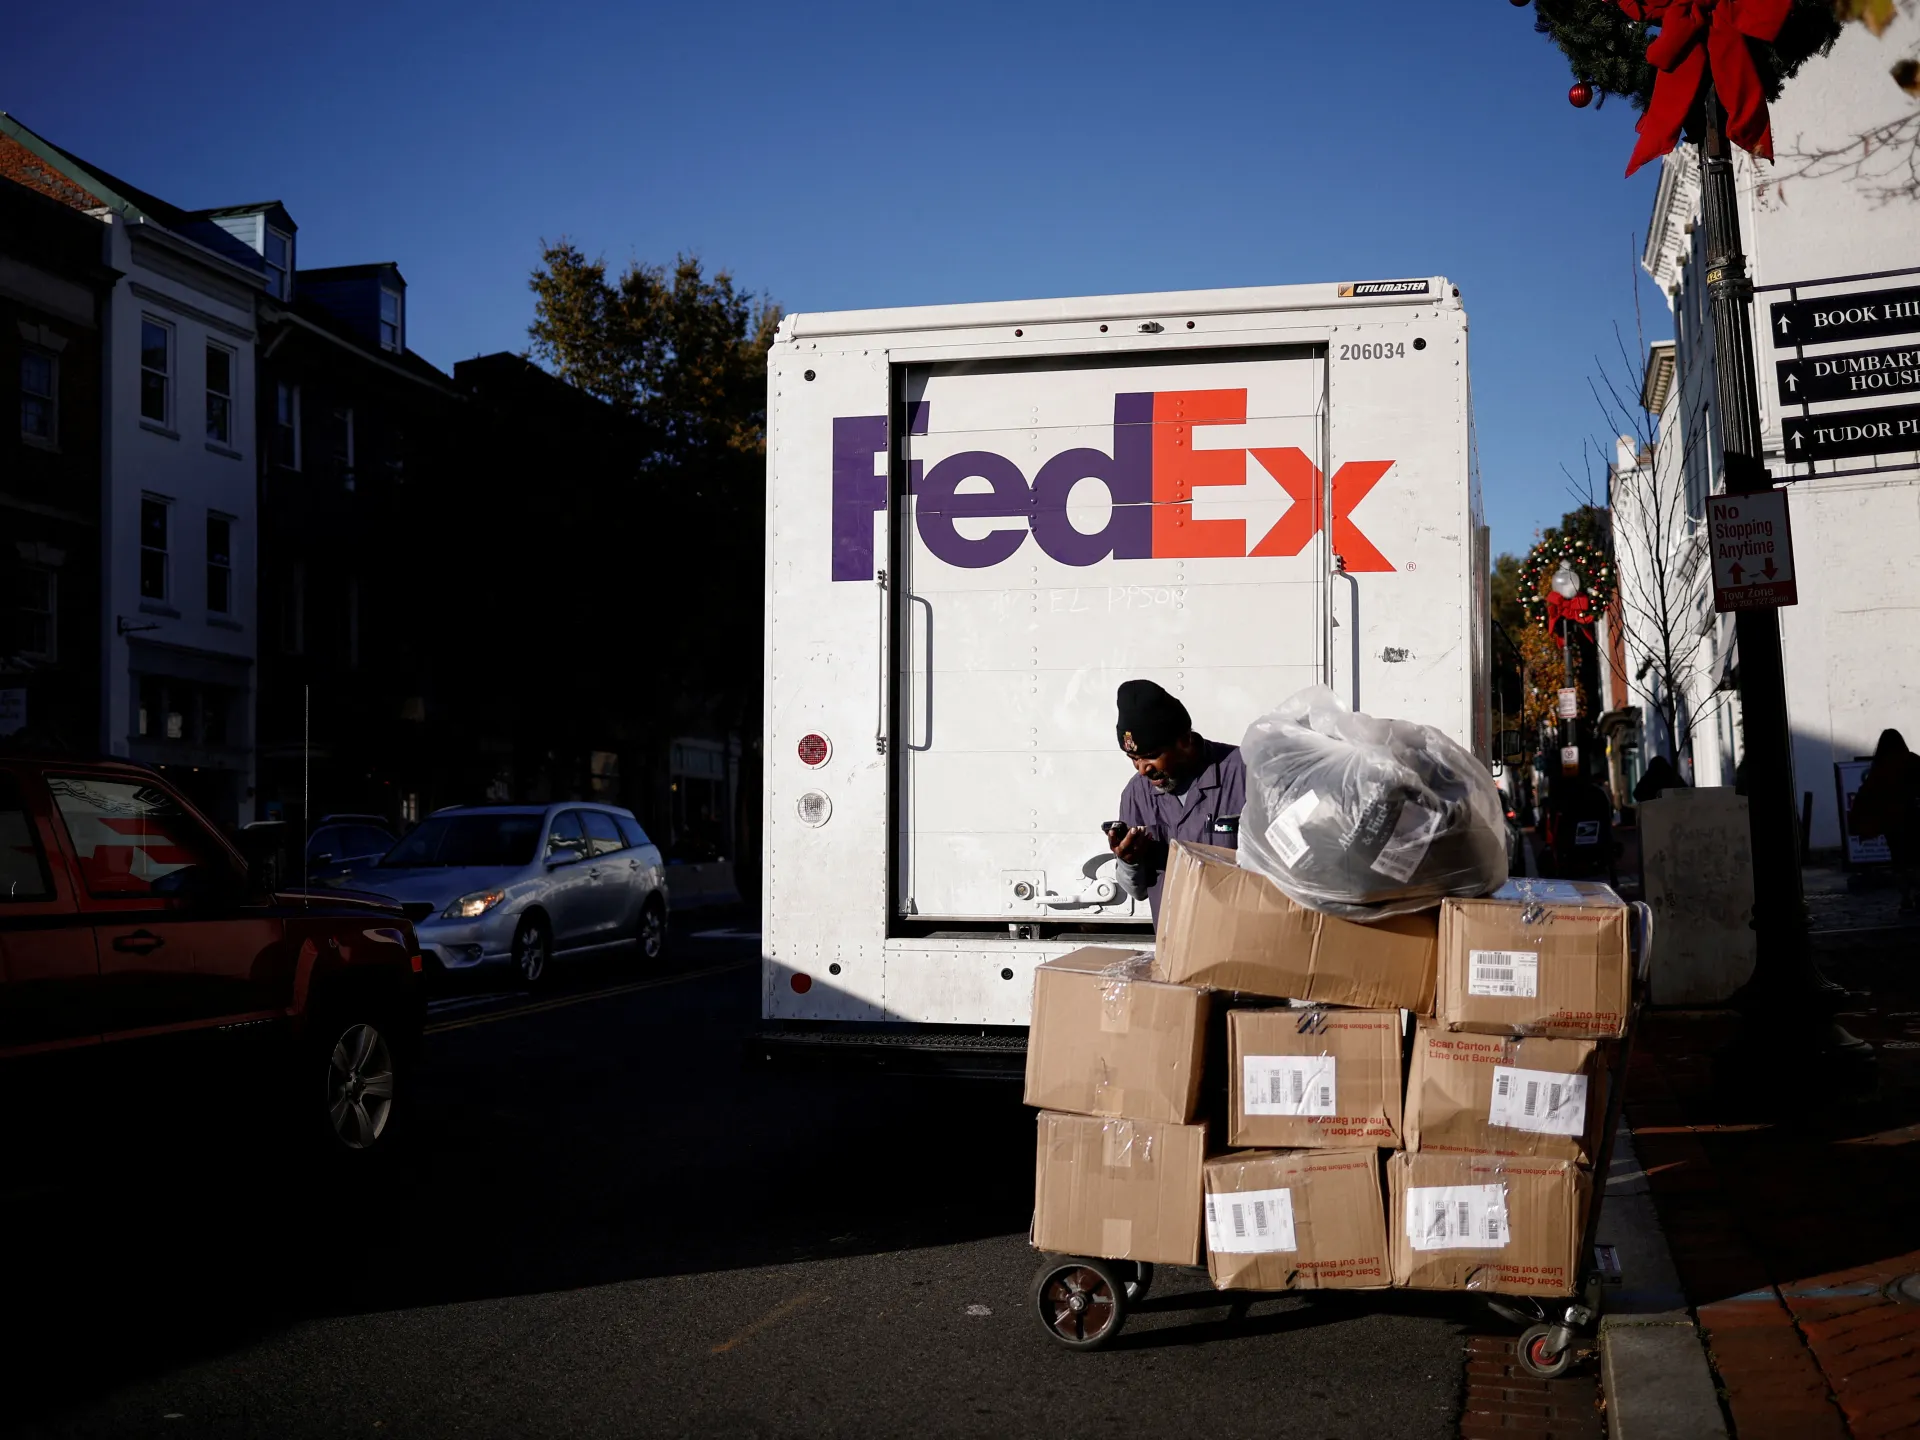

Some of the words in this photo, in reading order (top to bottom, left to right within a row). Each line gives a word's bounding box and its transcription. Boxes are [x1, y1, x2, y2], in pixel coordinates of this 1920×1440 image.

[1813, 305, 1878, 328] BOOK
[1339, 341, 1405, 362] 206034
[1813, 422, 1893, 444] TUDOR
[831, 388, 1397, 582] FedEx
[1714, 504, 1739, 520] No
[1716, 518, 1773, 540] Stopping
[1718, 539, 1775, 560] Anytime
[1722, 591, 1744, 600] Tow
[1748, 587, 1774, 598] Zone
[1723, 601, 1737, 609] Info
[1595, 1012, 1617, 1020] Line
[1553, 1021, 1589, 1029] Carton
[1429, 1038, 1454, 1049] Scan
[1456, 1041, 1490, 1052] Carton
[1493, 1043, 1514, 1053] Ad
[1429, 1050, 1450, 1060] Line
[1452, 1053, 1469, 1062] out
[1472, 1053, 1514, 1065] Barcode
[1351, 1116, 1368, 1125] out
[1331, 1128, 1364, 1137] Carton
[1366, 1129, 1391, 1137] Scan
[1296, 1260, 1337, 1269] Barcode
[1358, 1256, 1379, 1265] Line
[1320, 1269, 1353, 1278] Carton
[1355, 1267, 1381, 1277] Scan
[1522, 1265, 1539, 1274] out
[1541, 1267, 1563, 1276] Line
[1499, 1275, 1535, 1285] Carton
[1537, 1278, 1563, 1287] Scan
